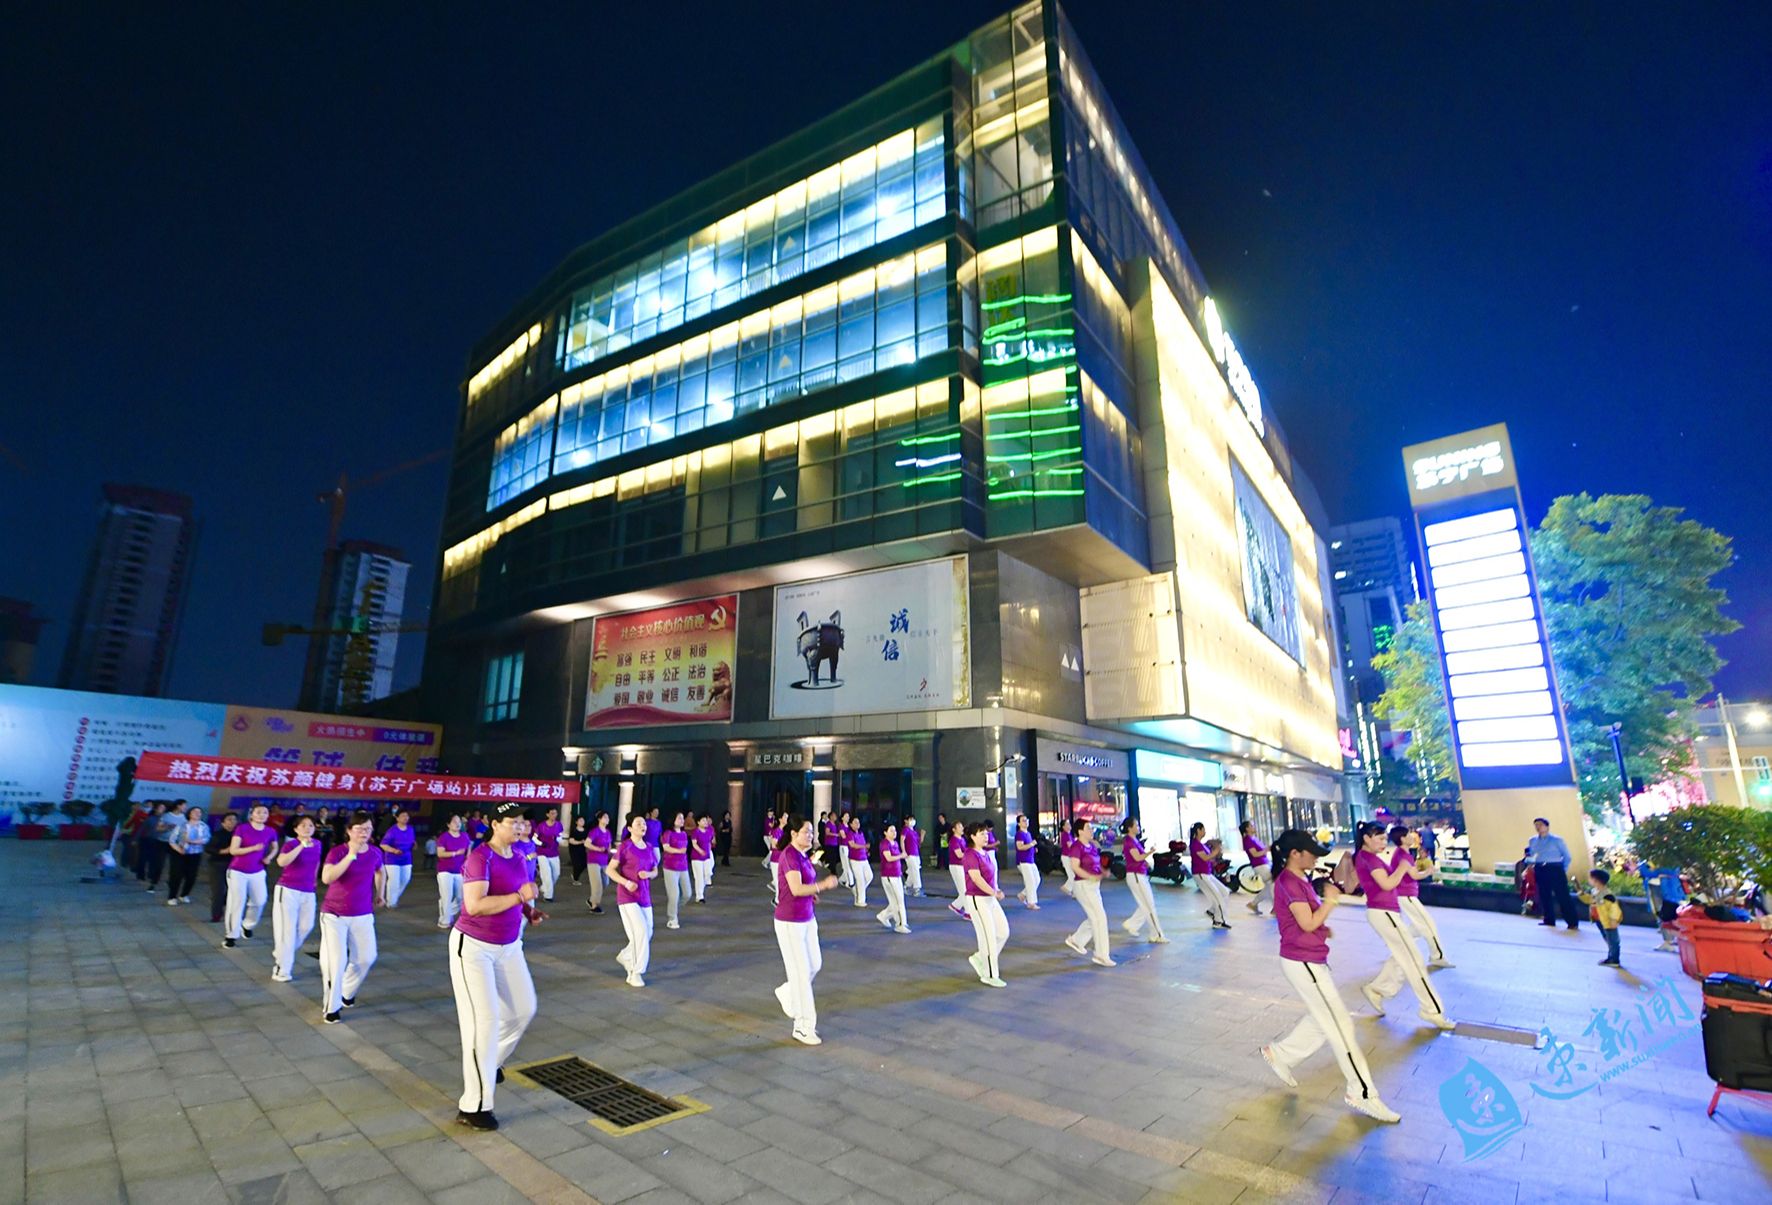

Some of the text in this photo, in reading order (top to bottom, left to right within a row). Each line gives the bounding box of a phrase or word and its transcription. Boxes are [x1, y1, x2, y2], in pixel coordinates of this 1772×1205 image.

[621, 614, 705, 639] 社会主义核心价值观
[882, 607, 910, 661] 诚信
[640, 650, 656, 665] 民主
[664, 646, 681, 661] 文明
[689, 643, 707, 659] 和谐
[615, 664, 706, 687] 自由 平等 公正 法治
[661, 687, 679, 703] 诚信
[687, 685, 705, 701] 友善
[754, 753, 802, 765] 星巴克咖啡
